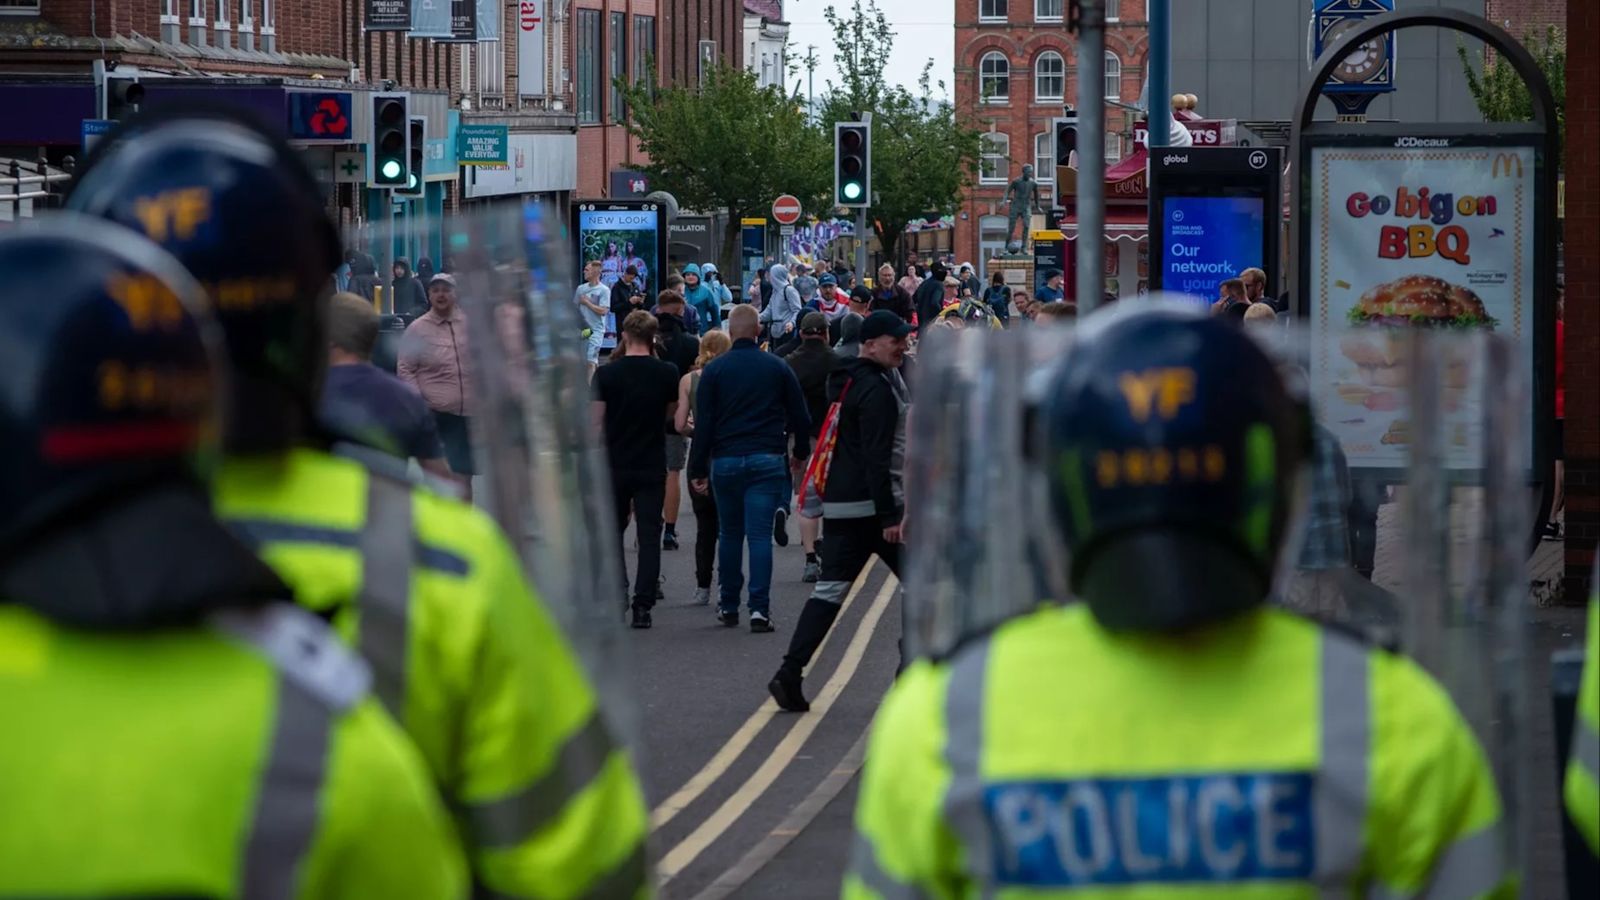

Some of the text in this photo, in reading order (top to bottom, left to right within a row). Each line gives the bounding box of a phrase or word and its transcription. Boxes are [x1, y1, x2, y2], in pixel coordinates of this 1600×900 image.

[467, 137, 499, 145] AMAZING
[472, 144, 494, 152] VALUE
[1394, 136, 1449, 147] JCDecaux
[465, 151, 500, 159] EVERYDAY
[1163, 154, 1188, 166] global
[1115, 177, 1143, 194] FUN
[1346, 186, 1497, 225] Go big on
[589, 216, 648, 225] NEW LOOK
[1171, 243, 1200, 257] Our
[1378, 225, 1470, 265] BBQ
[1171, 260, 1236, 276] network,
[1183, 279, 1217, 293] your
[1119, 366, 1197, 421] YF
[996, 776, 1306, 871] POLICE
